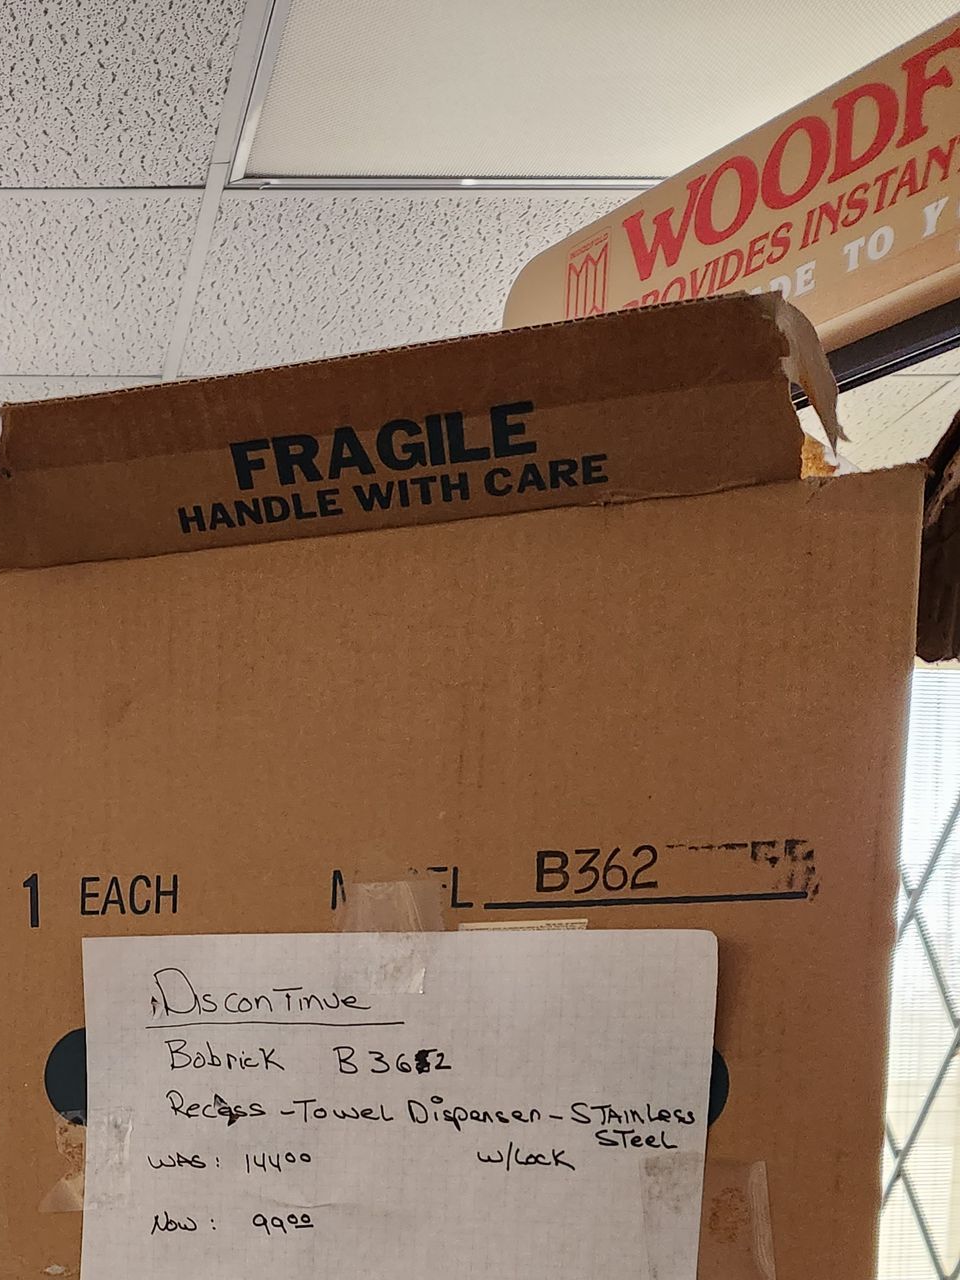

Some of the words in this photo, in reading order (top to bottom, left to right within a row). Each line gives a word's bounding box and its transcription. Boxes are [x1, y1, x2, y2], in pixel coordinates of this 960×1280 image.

[623, 222, 794, 308] ROVIDES
[799, 134, 960, 250] INSTAN
[843, 225, 895, 273] TO
[230, 401, 537, 490] FRAGILE
[178, 489, 344, 534] HANDLE
[353, 472, 471, 509] WITH
[483, 453, 609, 496] CARE
[22, 873, 40, 928] 1
[80, 874, 179, 916] EACH
[535, 844, 659, 894] B362
